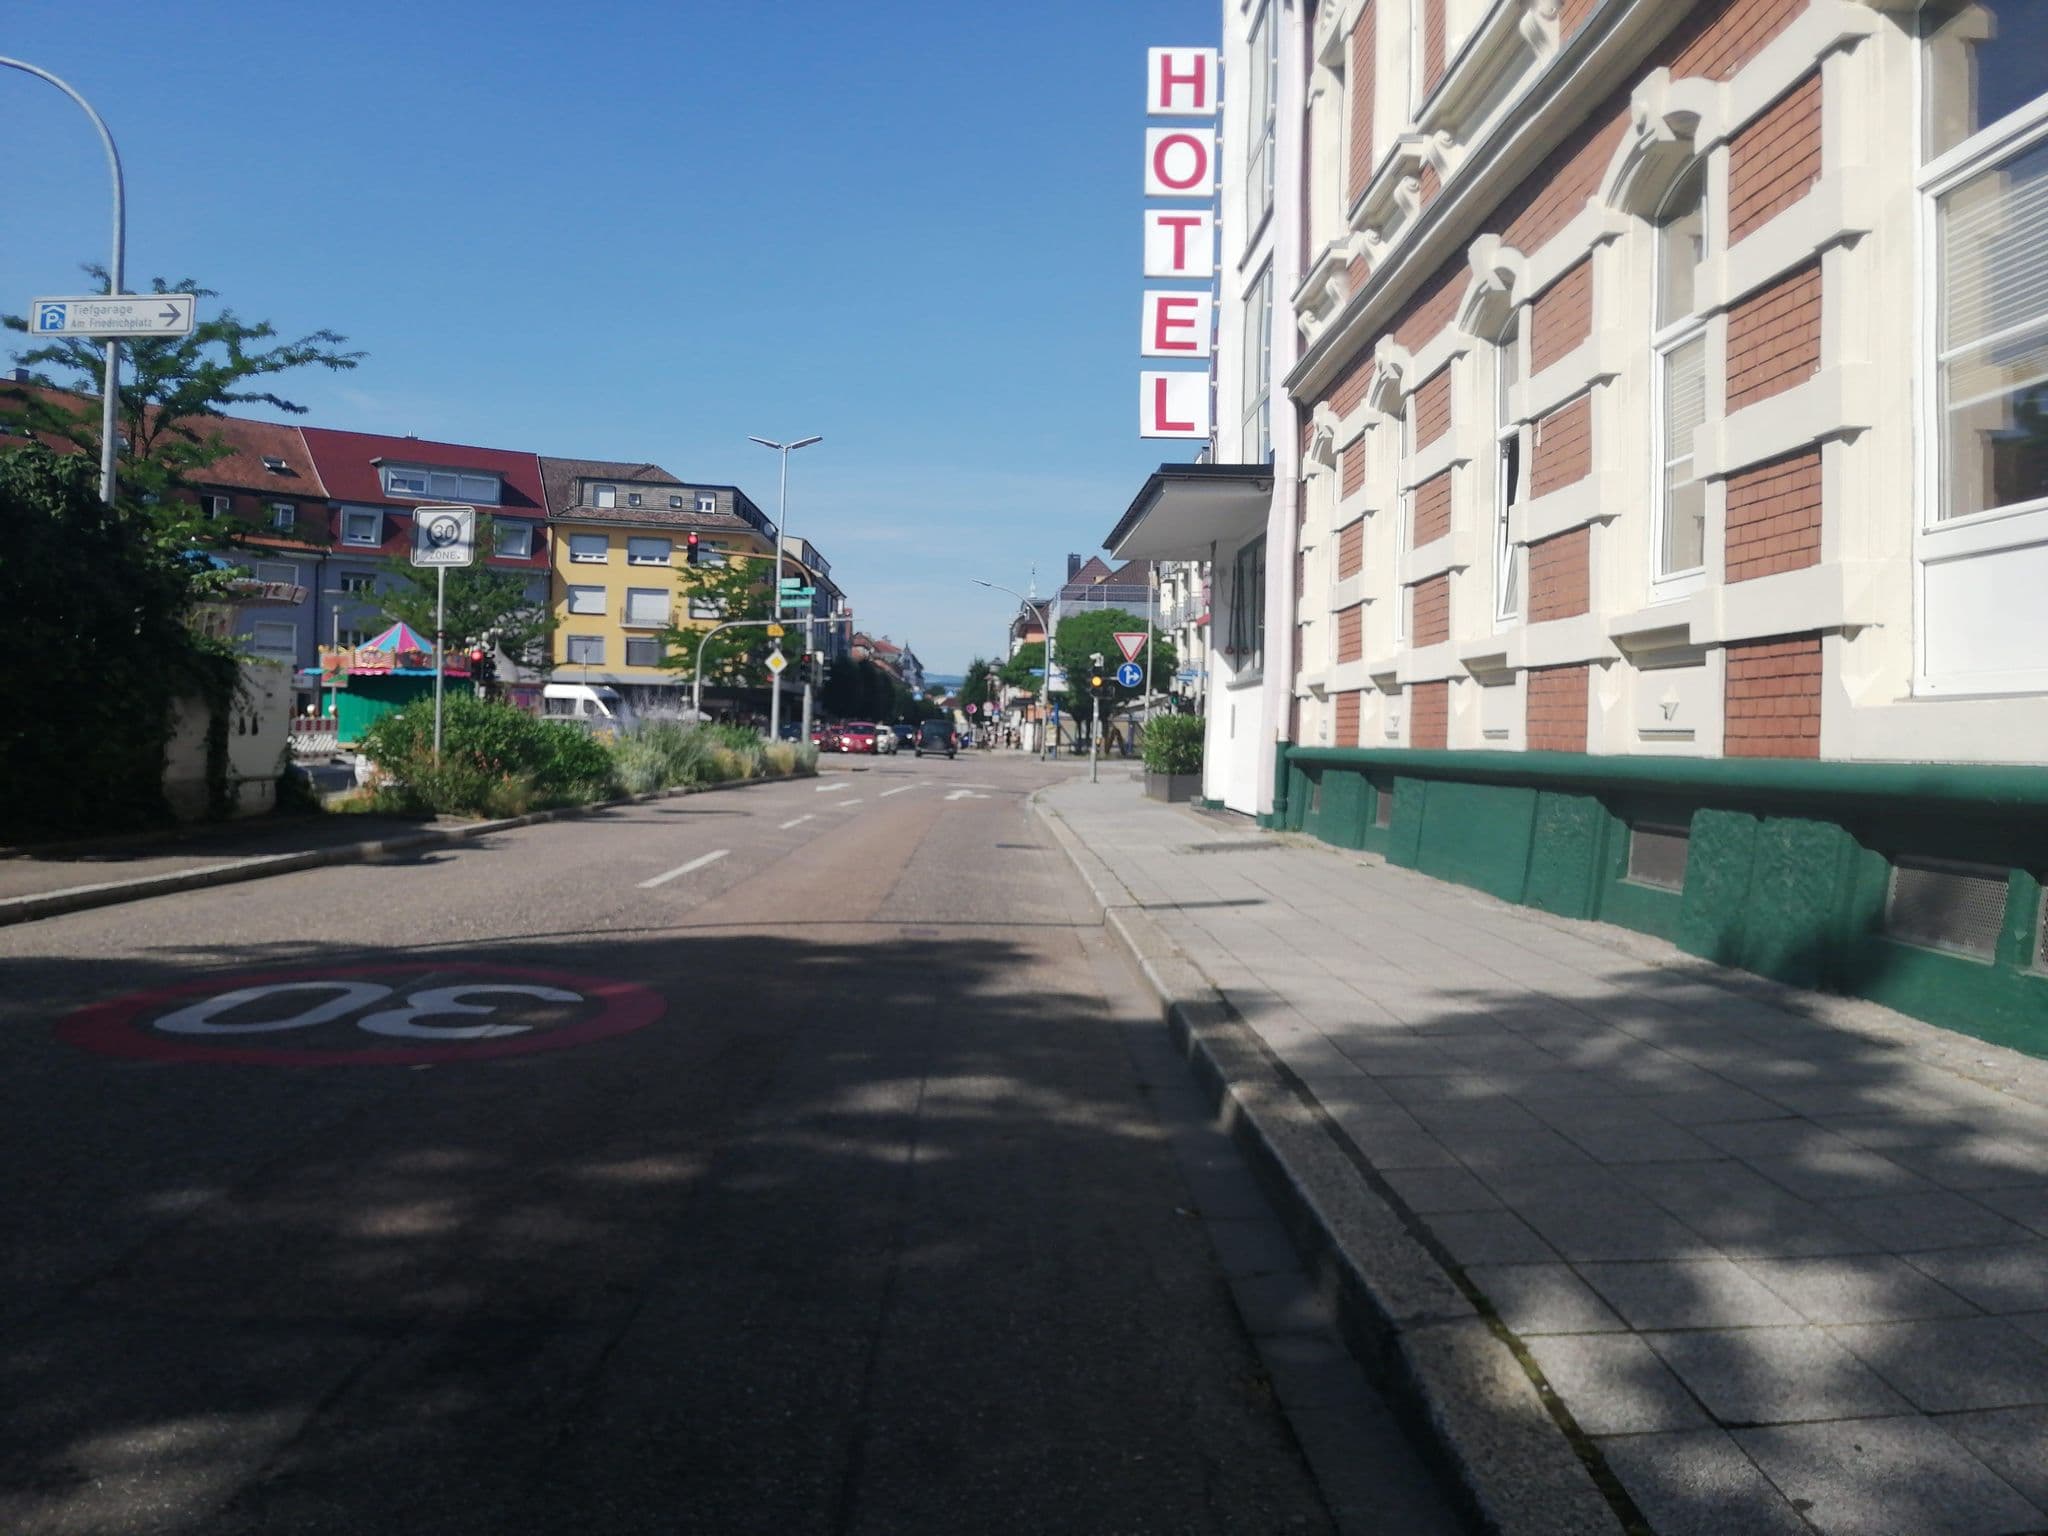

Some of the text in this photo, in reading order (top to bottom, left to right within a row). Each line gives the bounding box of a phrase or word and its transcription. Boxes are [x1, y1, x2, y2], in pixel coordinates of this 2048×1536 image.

[1153, 53, 1208, 432] HOTEL
[72, 304, 134, 317] Tiefgarage
[71, 320, 86, 328] Am
[433, 524, 455, 540] 30
[154, 982, 584, 1039] 30
